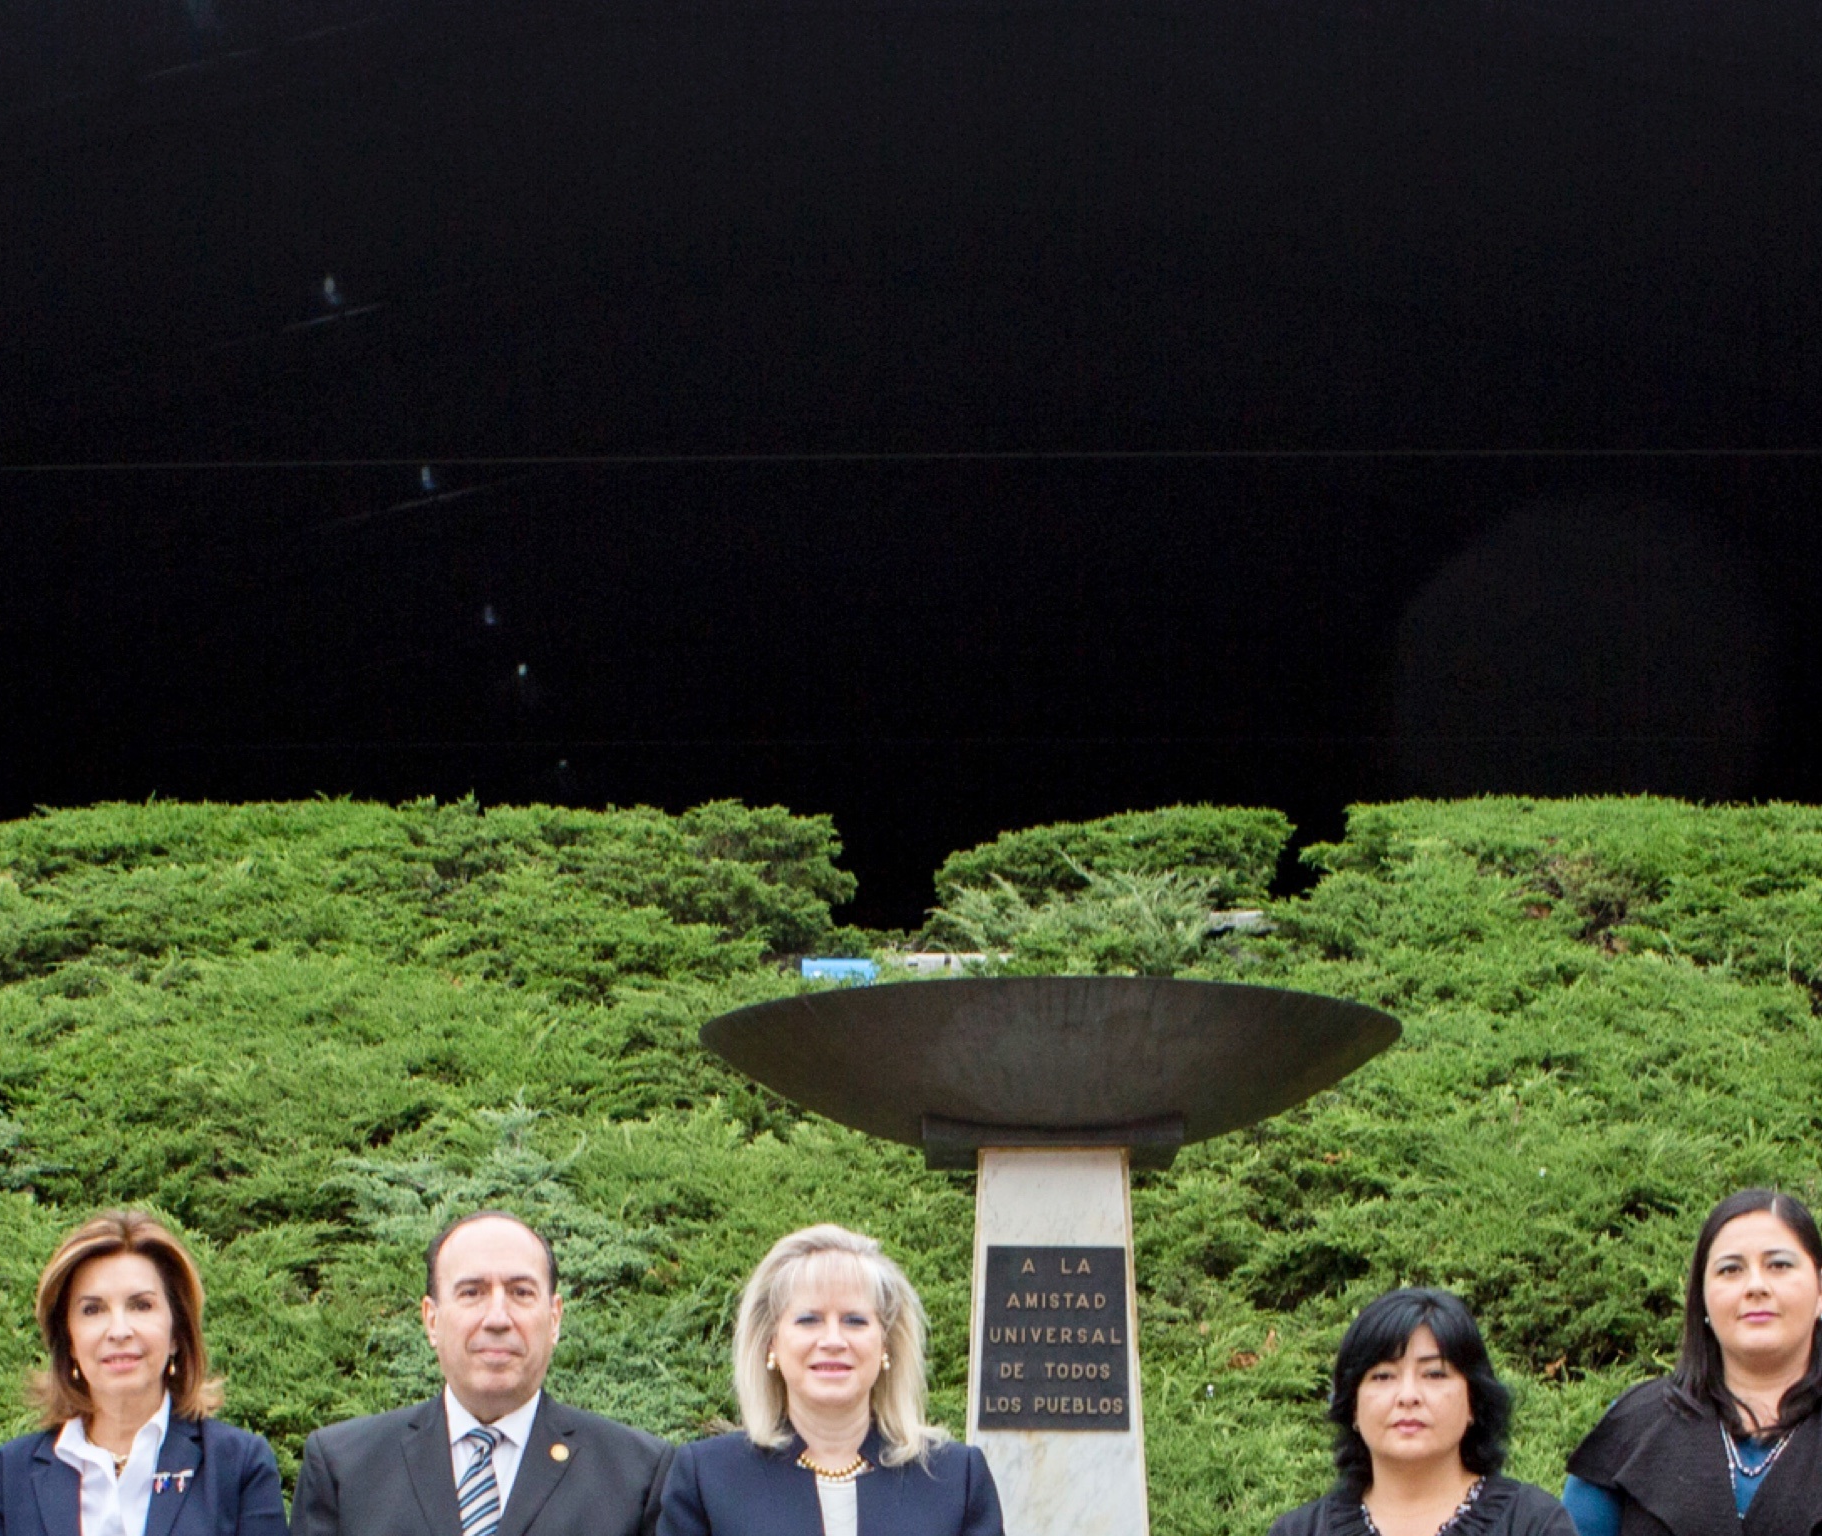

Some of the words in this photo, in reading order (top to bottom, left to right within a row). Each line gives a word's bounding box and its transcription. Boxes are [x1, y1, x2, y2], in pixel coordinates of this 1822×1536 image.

[1021, 1257, 1036, 1274] A
[1060, 1257, 1091, 1274] LA
[1006, 1292, 1106, 1309] AMISTAD
[989, 1326, 1122, 1344] UNIVERSAL
[999, 1361, 1024, 1379] DE
[1044, 1361, 1111, 1380] TODOS
[985, 1396, 1022, 1413] LOS
[1033, 1396, 1124, 1415] PUEBLOS
